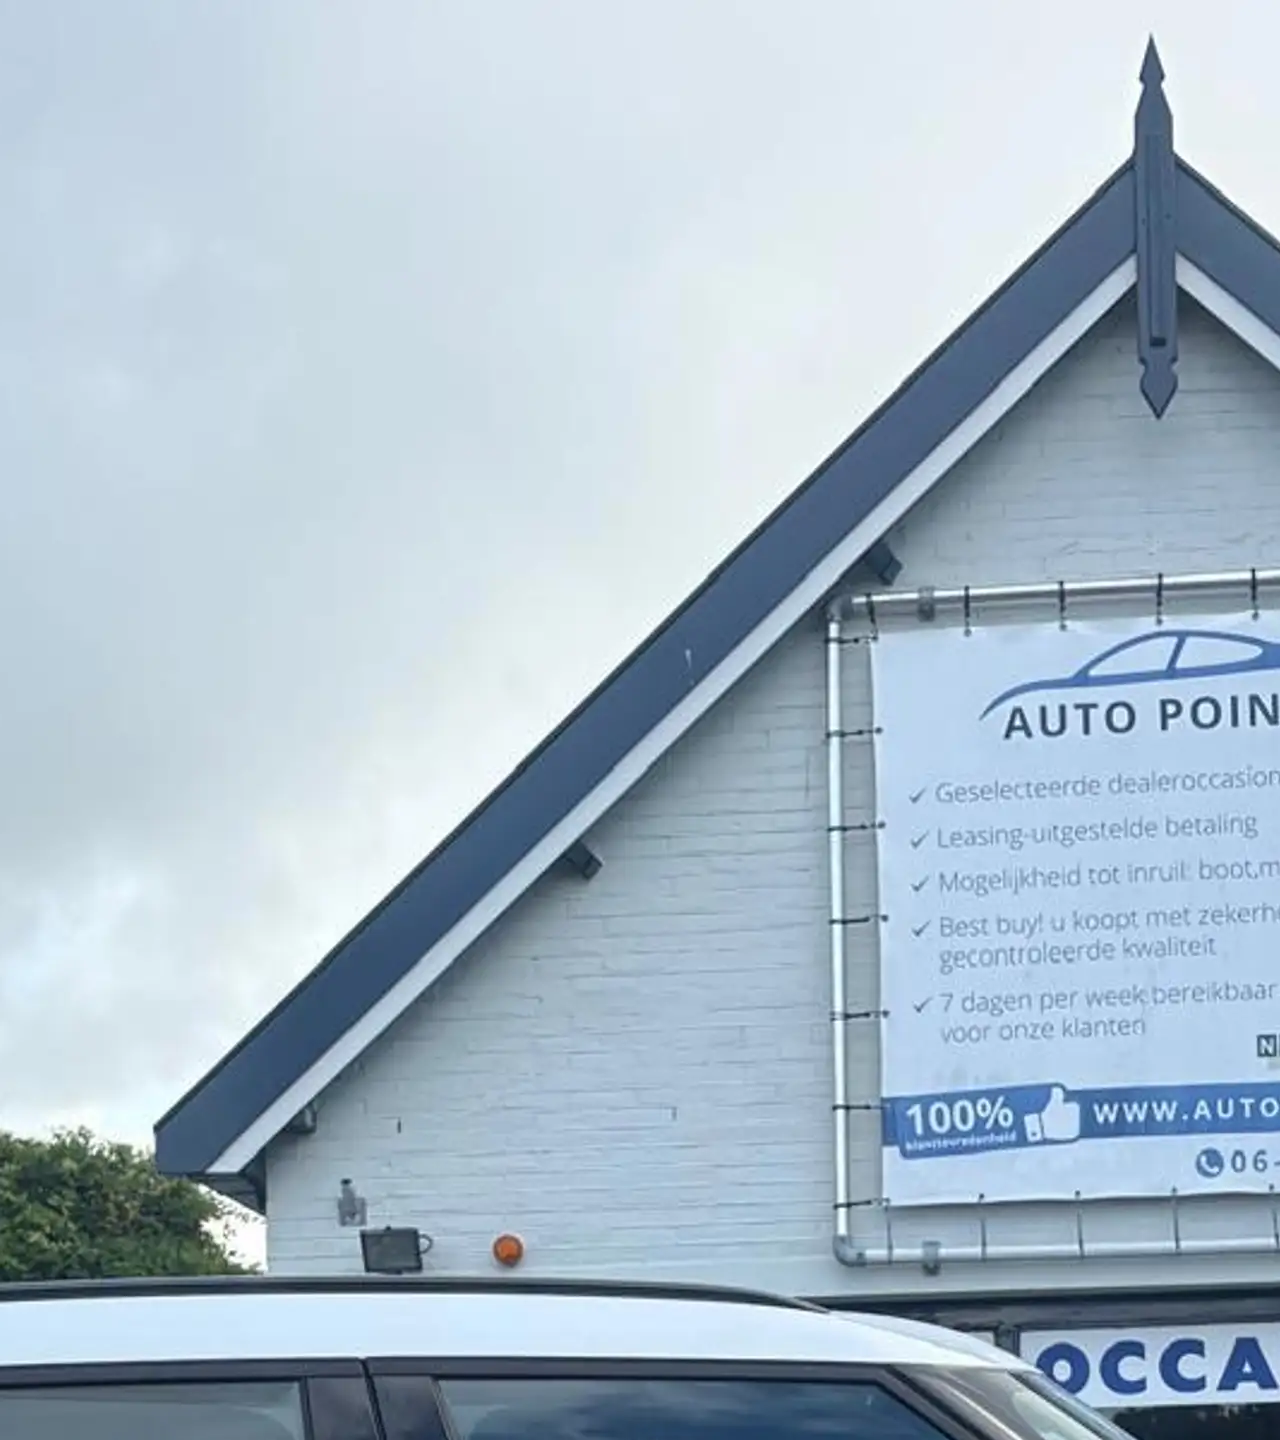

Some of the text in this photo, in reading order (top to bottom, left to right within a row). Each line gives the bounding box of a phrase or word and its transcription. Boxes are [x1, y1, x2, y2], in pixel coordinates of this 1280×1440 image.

[1003, 700, 1137, 740] AUTO
[934, 776, 1101, 804] Geselecteerde
[936, 814, 1259, 850] Leasing-uitgestelde betaling
[938, 860, 1081, 896] Mogelijkheid
[1088, 864, 1121, 885] tot
[939, 916, 989, 938] Best
[995, 912, 1043, 940] buy!
[1051, 915, 1066, 933] u
[1072, 909, 1139, 936] koopt
[1146, 906, 1192, 928] met
[939, 935, 1218, 975] gecontroleerde kwaliteit
[940, 992, 955, 1013] 7
[960, 990, 1033, 1017] dagen
[1040, 989, 1078, 1014] per
[1084, 983, 1149, 1009] week
[1151, 977, 1279, 1005] bereikbaar
[940, 1015, 1147, 1045] voor onze klanten
[906, 1095, 1015, 1136] 100%
